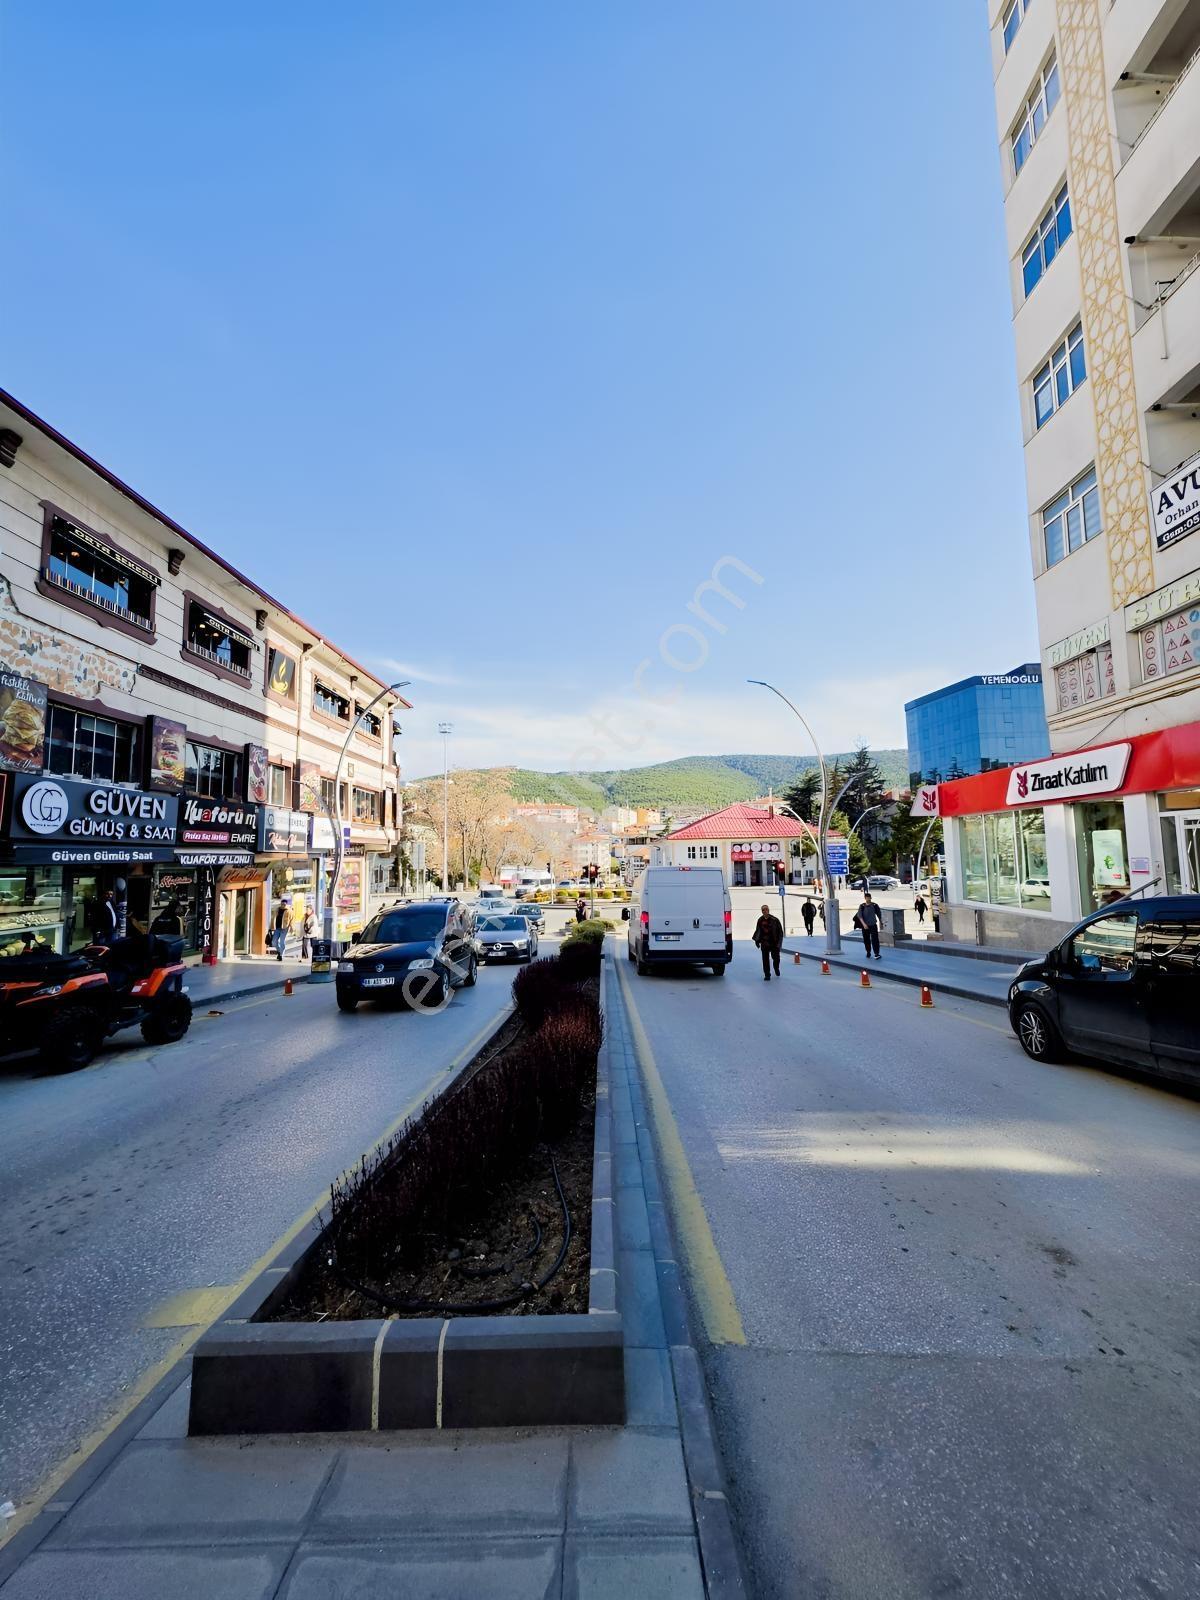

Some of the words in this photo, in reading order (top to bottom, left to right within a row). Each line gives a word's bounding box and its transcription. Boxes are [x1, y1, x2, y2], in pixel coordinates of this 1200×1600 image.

[1165, 500, 1199, 525] Orhan
[74, 528, 111, 555] ORTA
[90, 788, 167, 820] GÜVEN
[69, 817, 124, 840] GÜMÜŞ
[129, 823, 139, 838] &
[144, 825, 176, 841] SAAT
[230, 833, 256, 843] EMRE
[52, 851, 91, 861] Güven
[93, 851, 130, 862] Gümüş
[132, 851, 153, 861] Saat
[217, 855, 250, 864] SALONU
